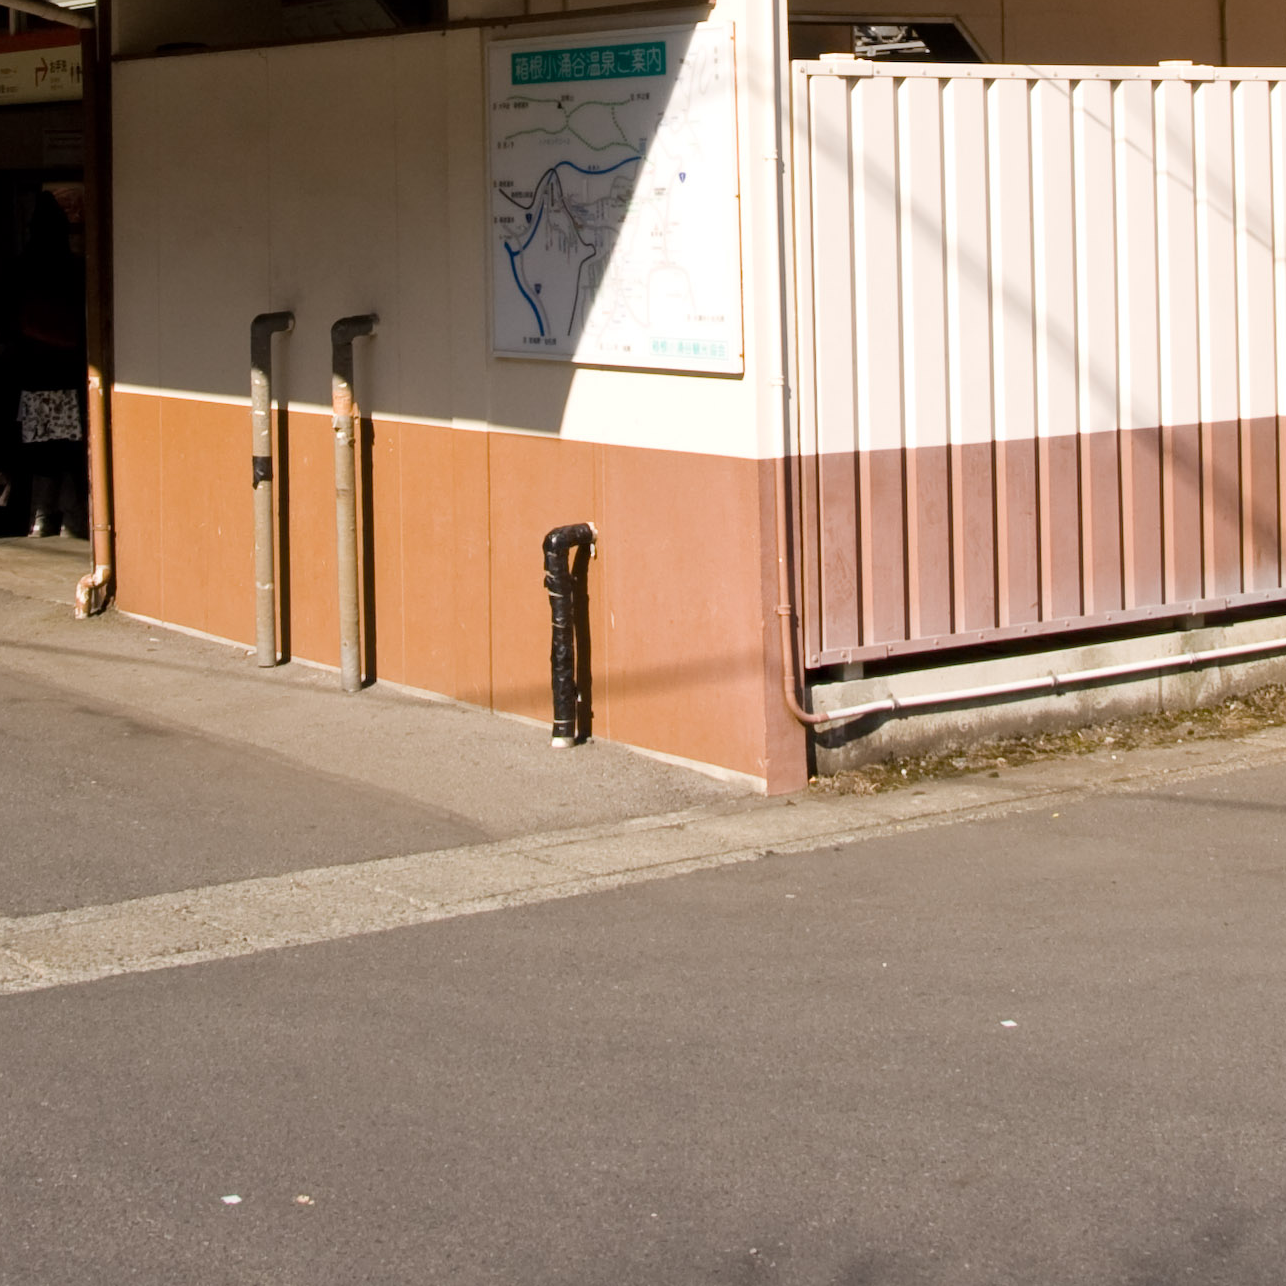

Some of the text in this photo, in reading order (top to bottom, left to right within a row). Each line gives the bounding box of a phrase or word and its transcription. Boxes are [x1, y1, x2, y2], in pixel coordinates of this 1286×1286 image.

[514, 46, 662, 82] 箱根小涌谷温泉ご案内
